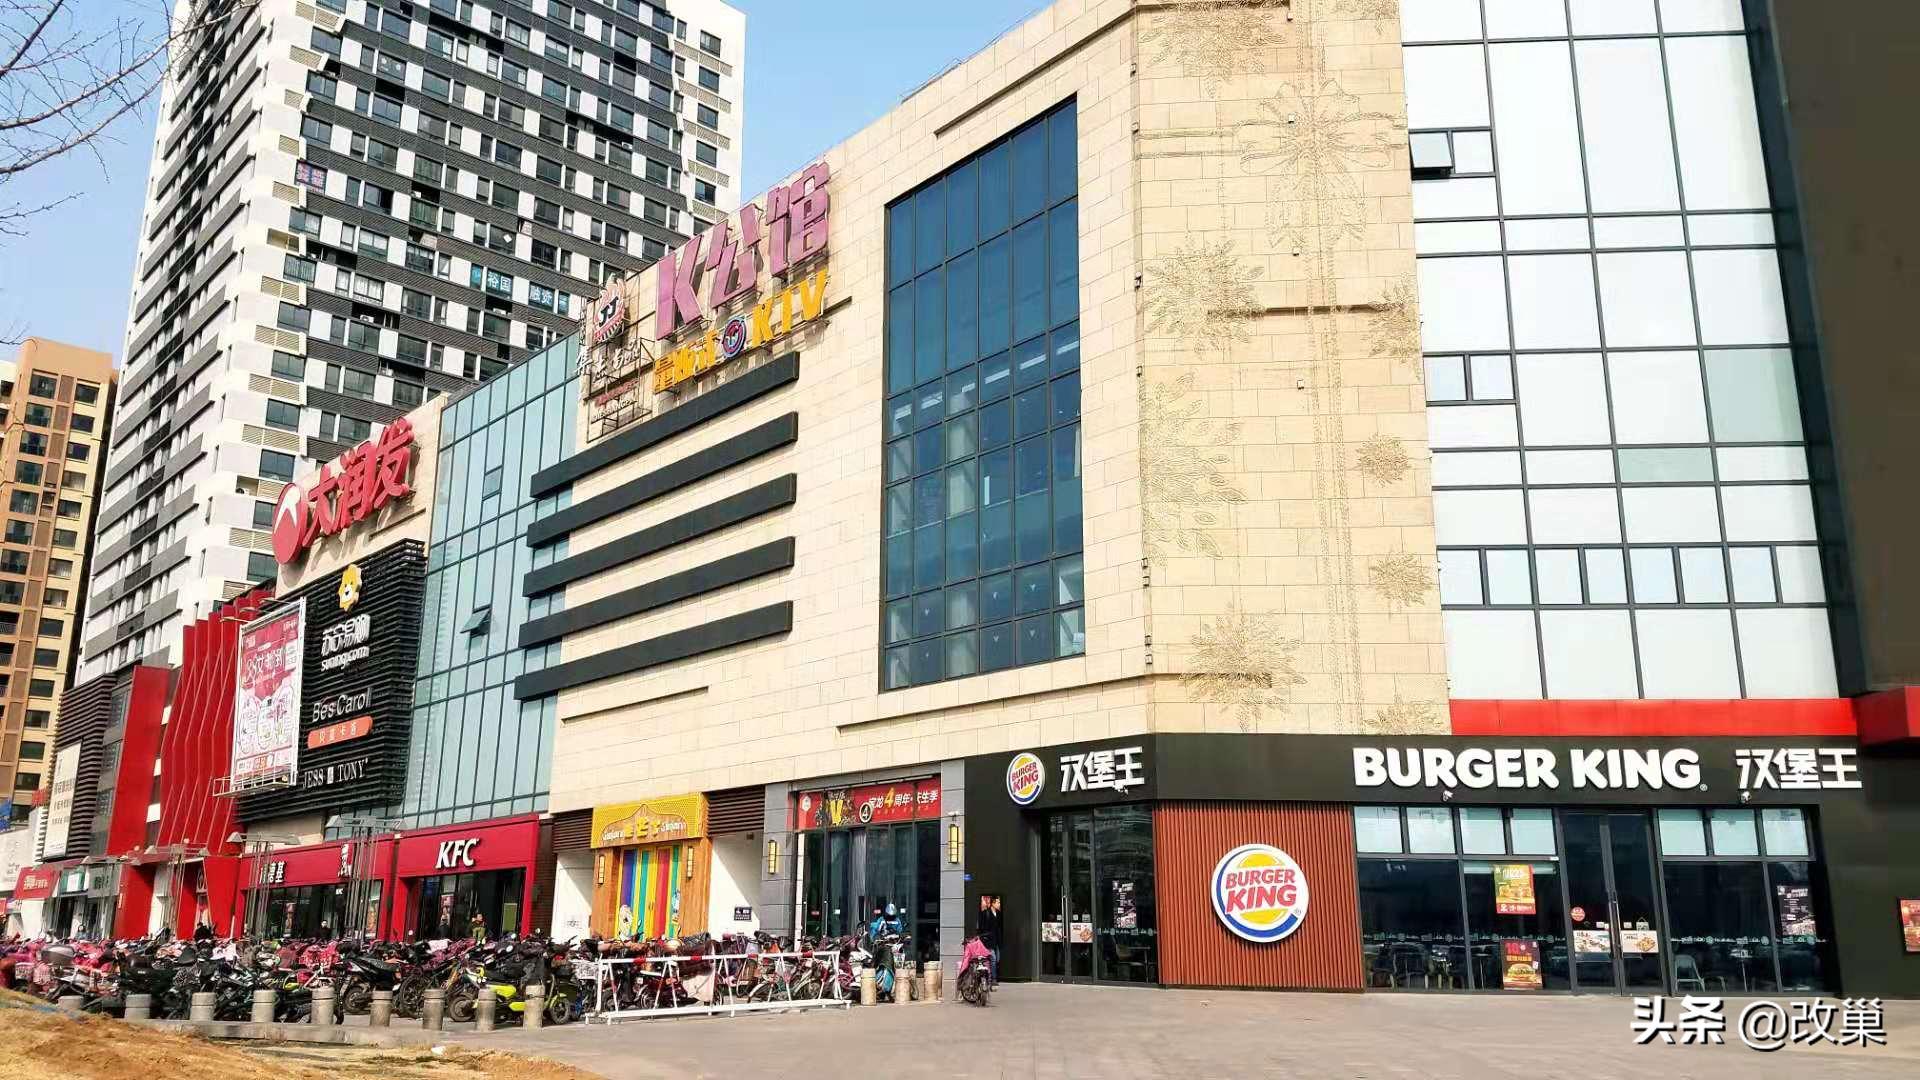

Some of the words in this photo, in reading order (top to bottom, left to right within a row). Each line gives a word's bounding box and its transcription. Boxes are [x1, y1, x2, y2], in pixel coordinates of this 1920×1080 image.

[656, 161, 831, 340] K公馆
[302, 417, 414, 547] 大润发
[321, 613, 371, 656] 苏宁易购
[303, 768, 324, 789] JESS
[337, 760, 365, 783] TONY
[1011, 762, 1037, 781] BURGER
[1012, 770, 1039, 791] KING
[1060, 747, 1145, 792] 汉堡王
[1352, 748, 1559, 790] BURGER
[1569, 748, 1701, 790] KING
[1736, 748, 1863, 790] 汉堡王
[435, 838, 478, 869] KFC
[1226, 869, 1296, 889] BURGER
[1226, 884, 1297, 912] KING
